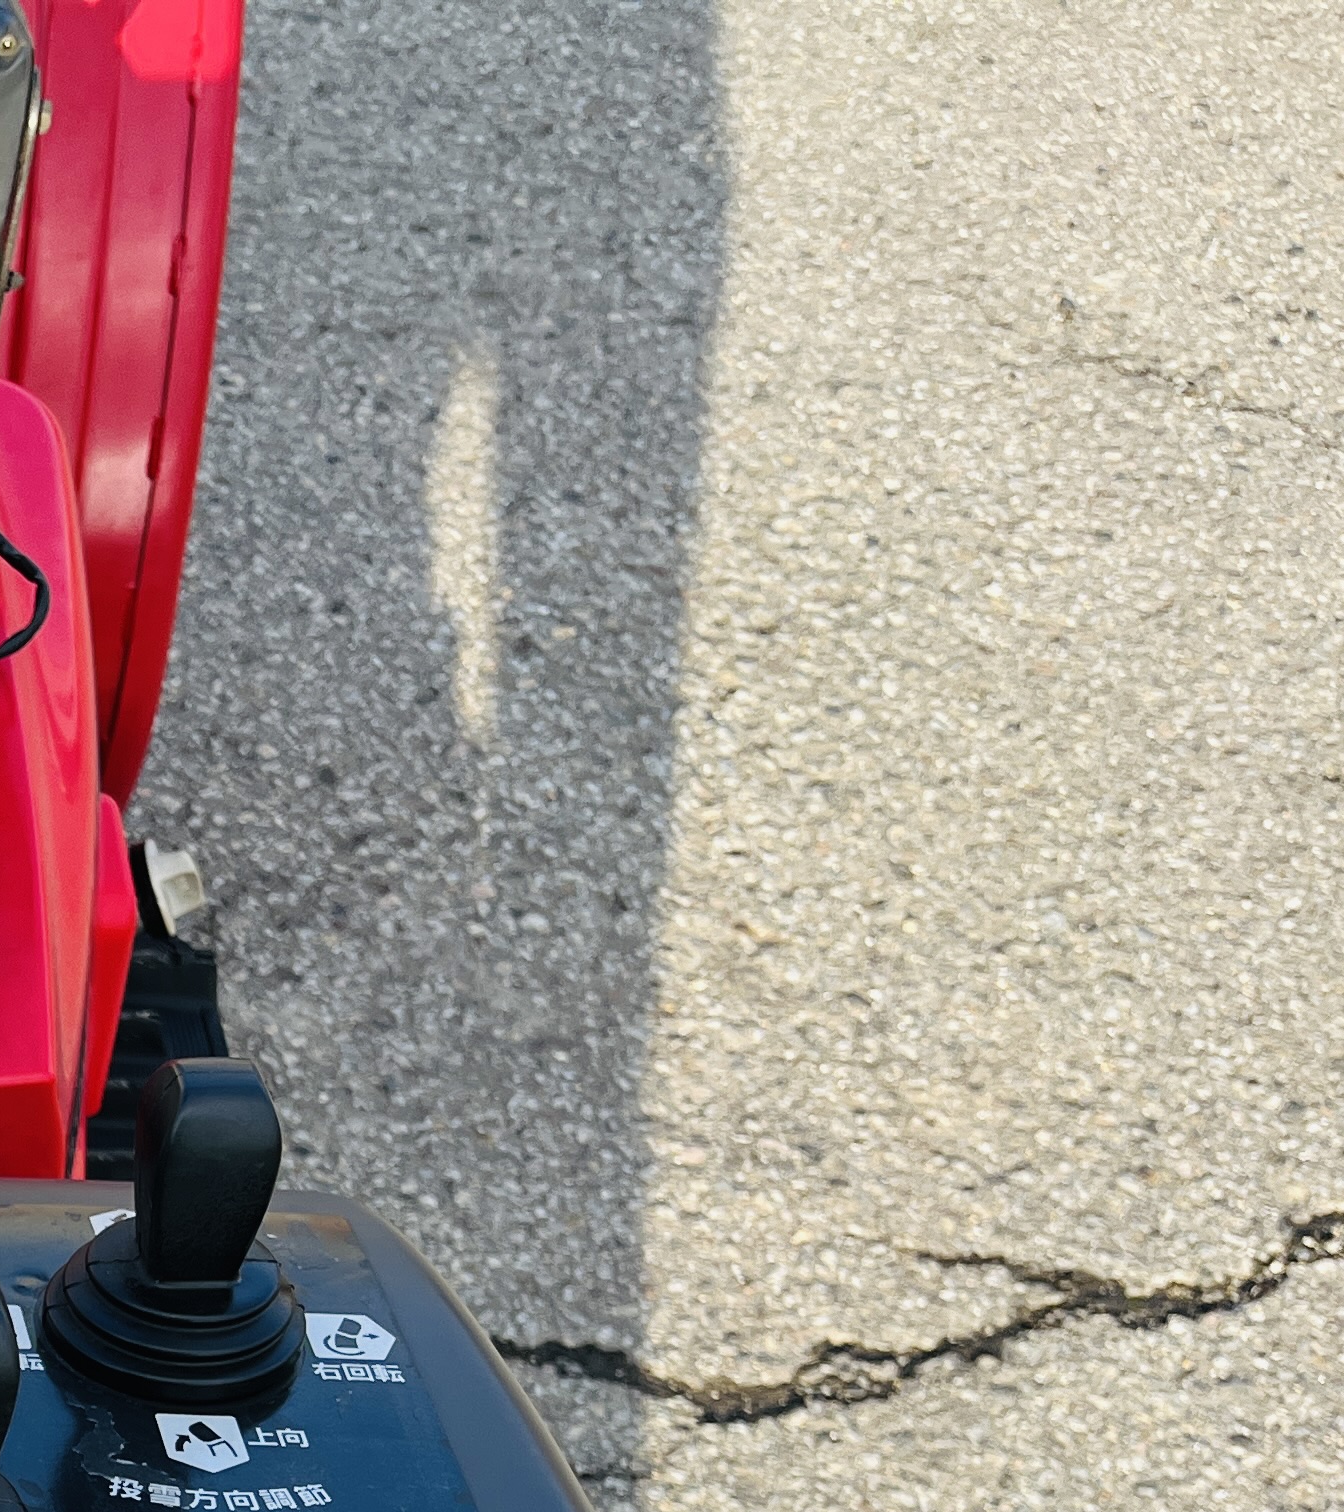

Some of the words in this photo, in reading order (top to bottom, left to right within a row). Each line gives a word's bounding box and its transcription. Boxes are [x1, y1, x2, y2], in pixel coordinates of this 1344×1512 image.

[312, 1362, 405, 1385] 右回転
[247, 1427, 310, 1449] 上向
[110, 1475, 333, 1512] 投雪方向調節
